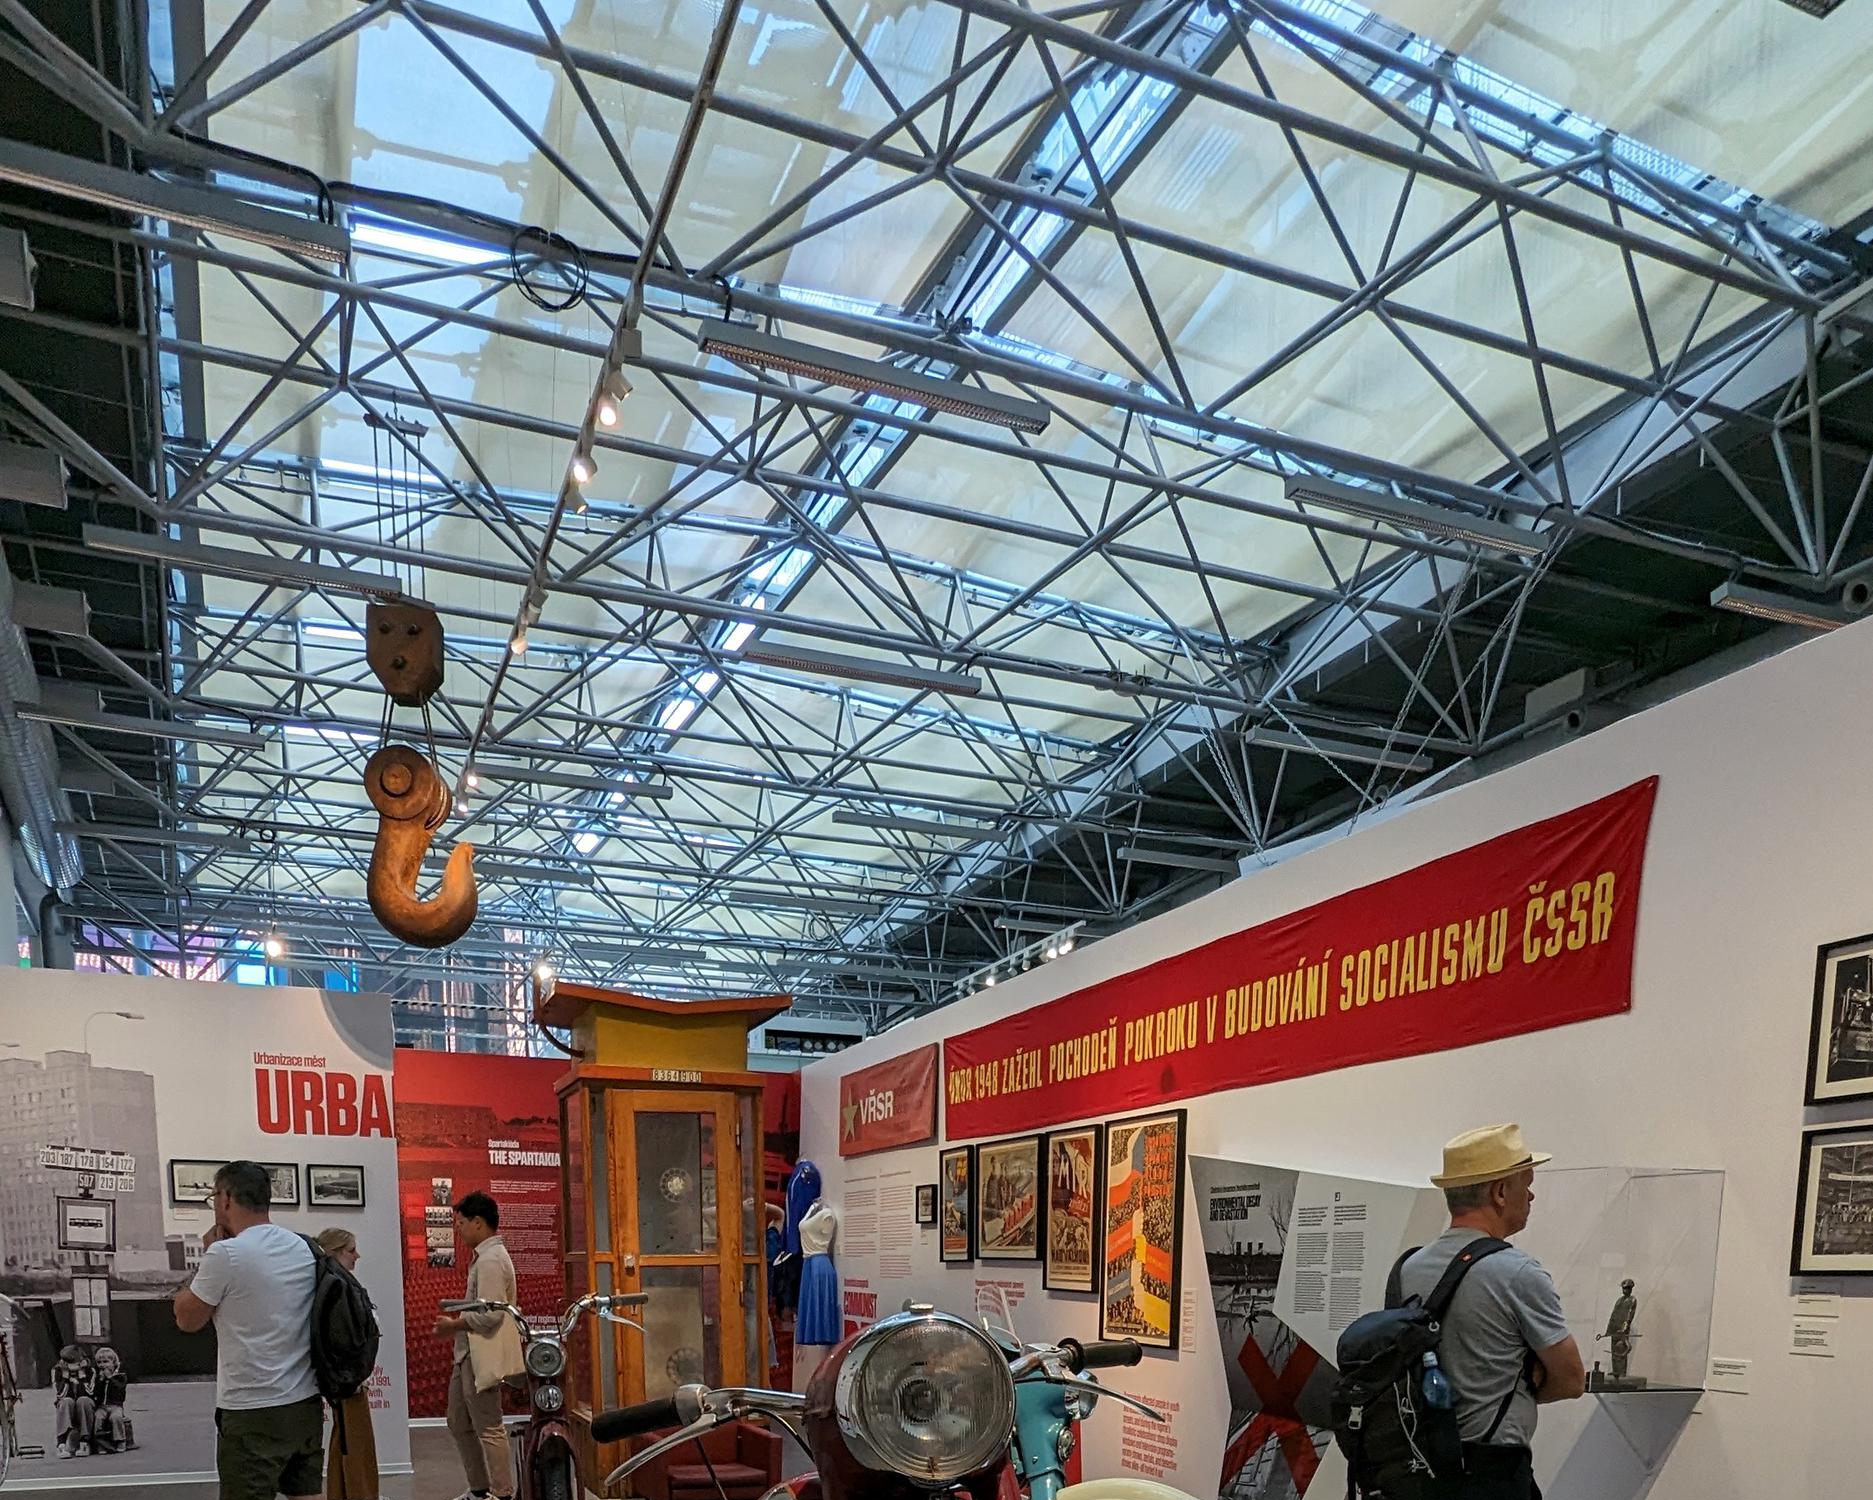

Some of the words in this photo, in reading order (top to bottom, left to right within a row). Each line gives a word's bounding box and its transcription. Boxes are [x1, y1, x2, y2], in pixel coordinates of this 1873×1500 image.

[974, 1061, 998, 1099] 1948
[1001, 1047, 1043, 1096] ZAŽEHL
[1049, 1016, 1118, 1084] POCHODEŇ
[1124, 1001, 1198, 1066] POKROKU
[1206, 995, 1218, 1044] V
[1224, 949, 1333, 1039] BUDOVÁNÍ
[1340, 907, 1508, 1012] SOCIALISMU
[1522, 871, 1616, 964] ČSSR
[254, 1052, 303, 1067] Urbanizace
[255, 1068, 395, 1138] URBA
[859, 1089, 894, 1125] VŘSR
[488, 1150, 508, 1165] THE
